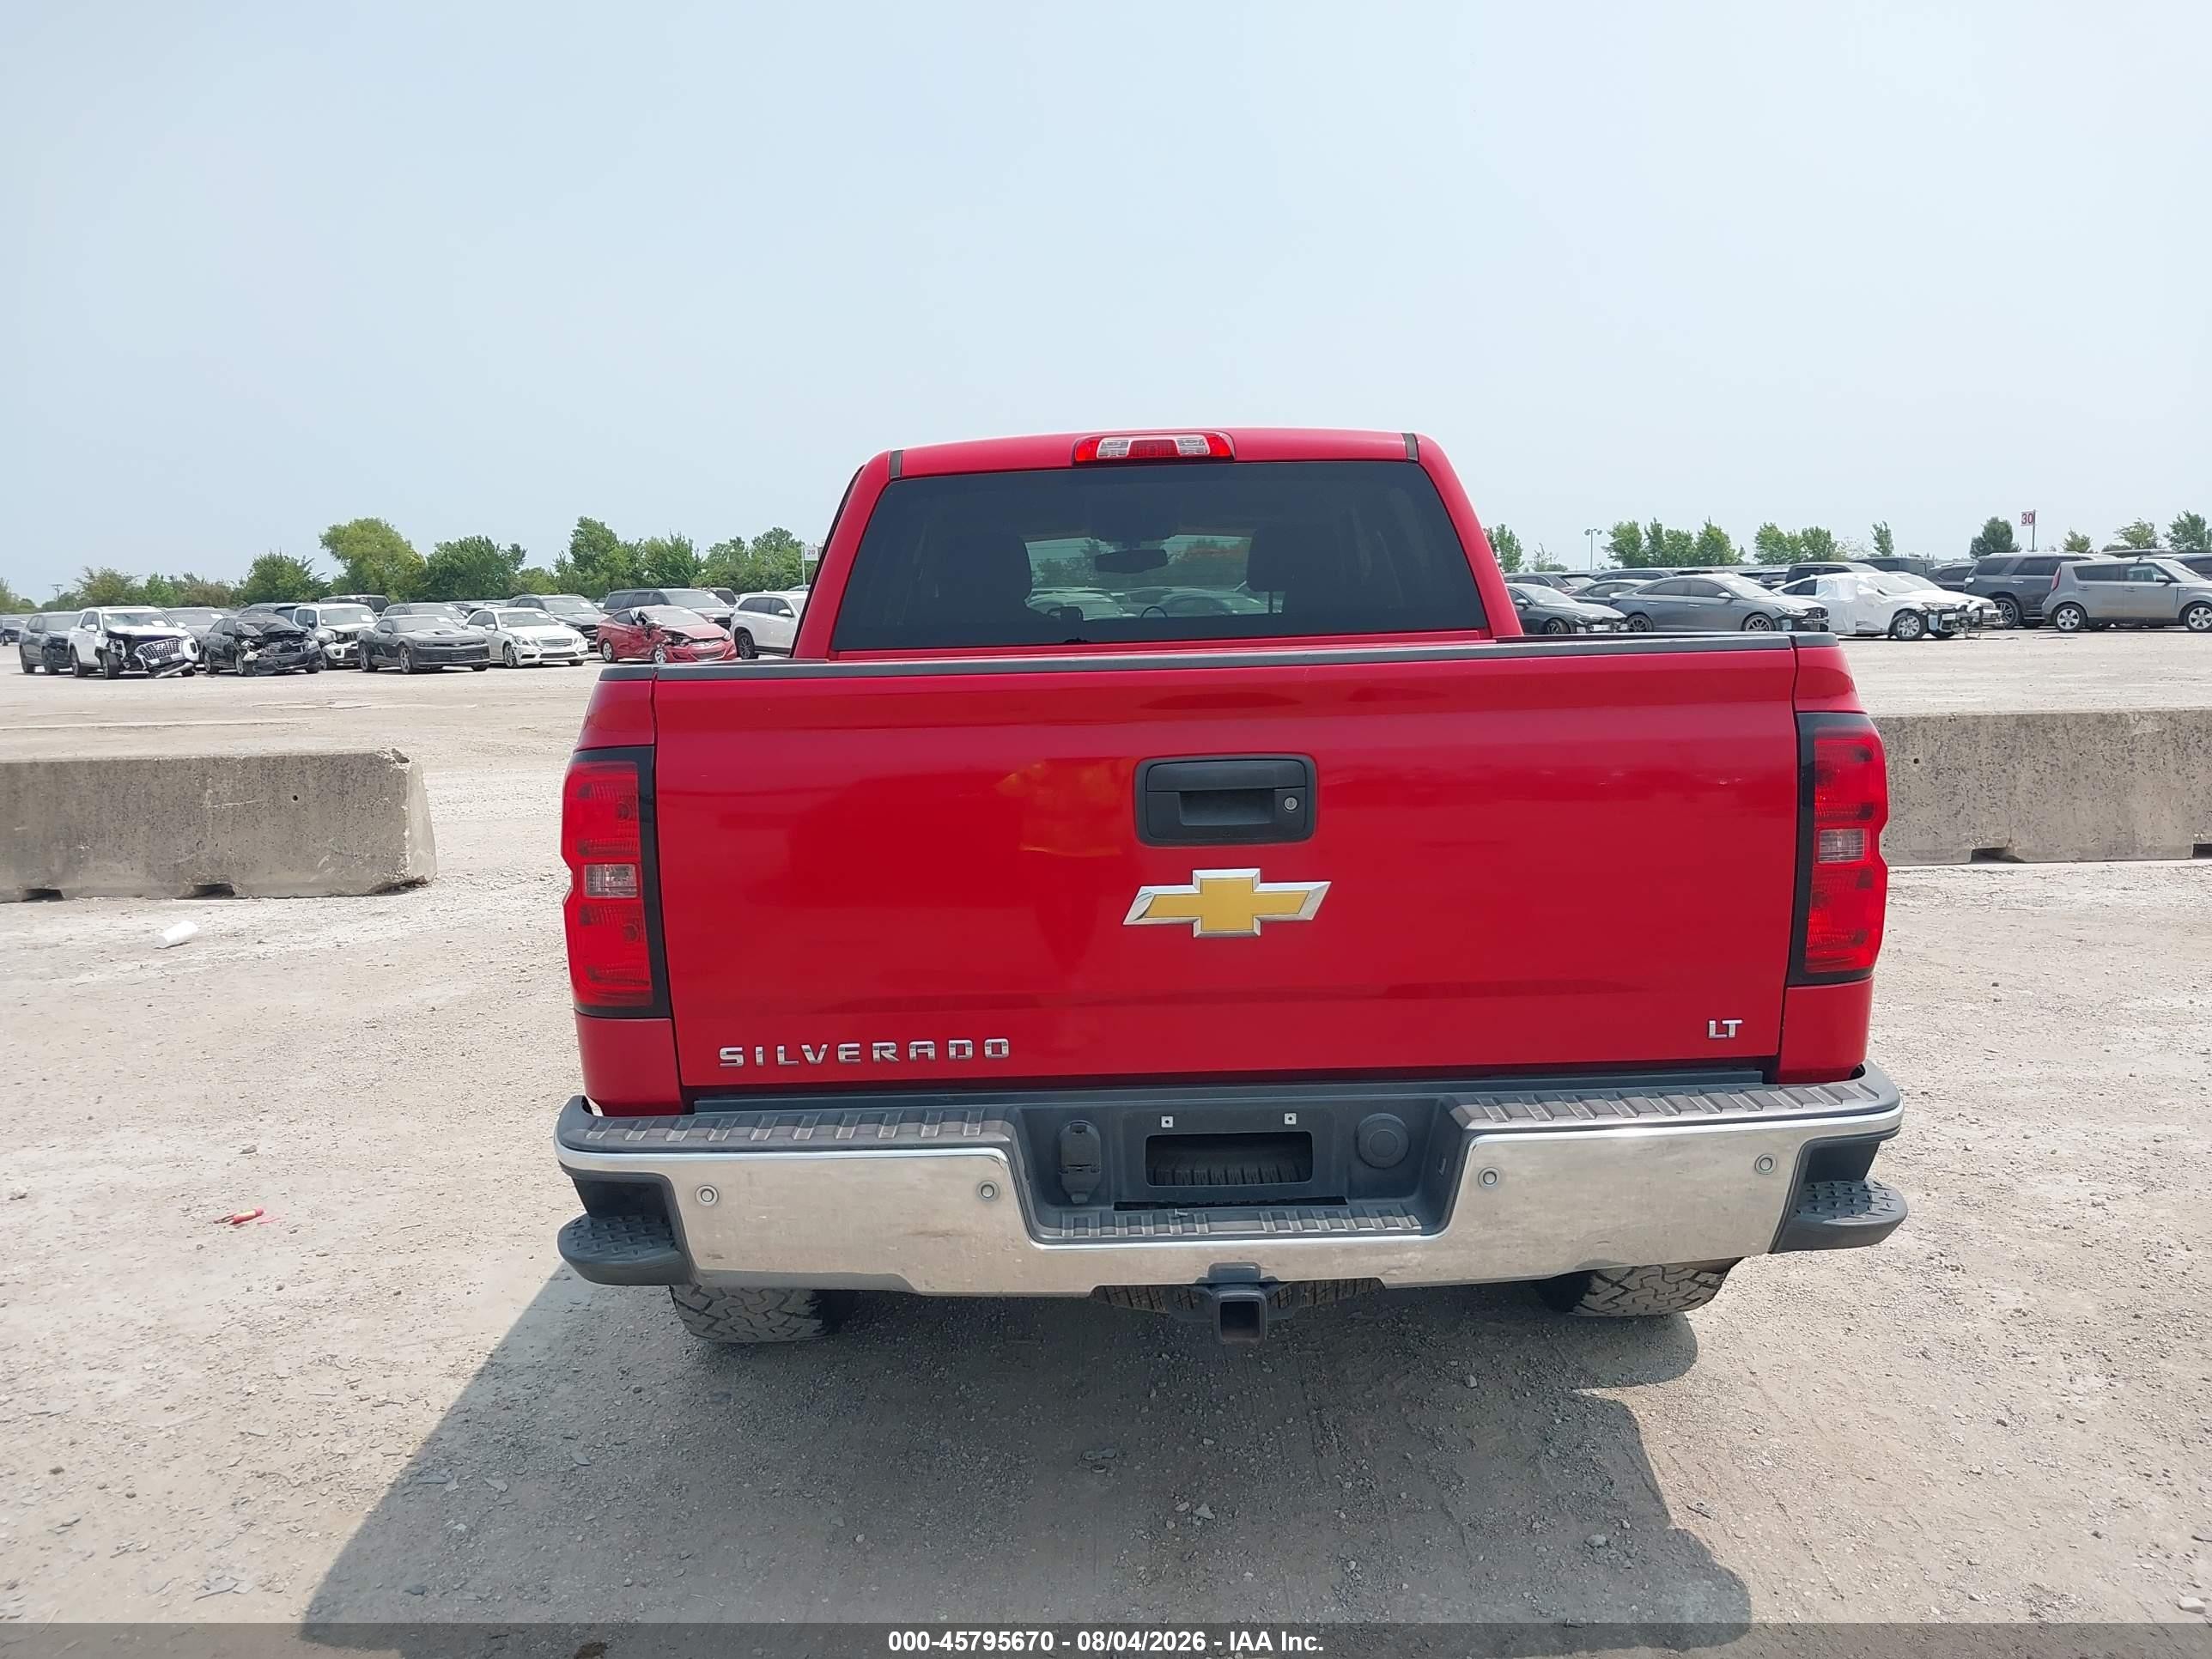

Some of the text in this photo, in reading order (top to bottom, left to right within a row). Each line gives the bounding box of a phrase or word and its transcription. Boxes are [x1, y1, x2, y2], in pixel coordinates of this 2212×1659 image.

[2021, 513, 2033, 525] 30
[1708, 1019, 1743, 1039] LT
[718, 1037, 1011, 1068] SILVERADO
